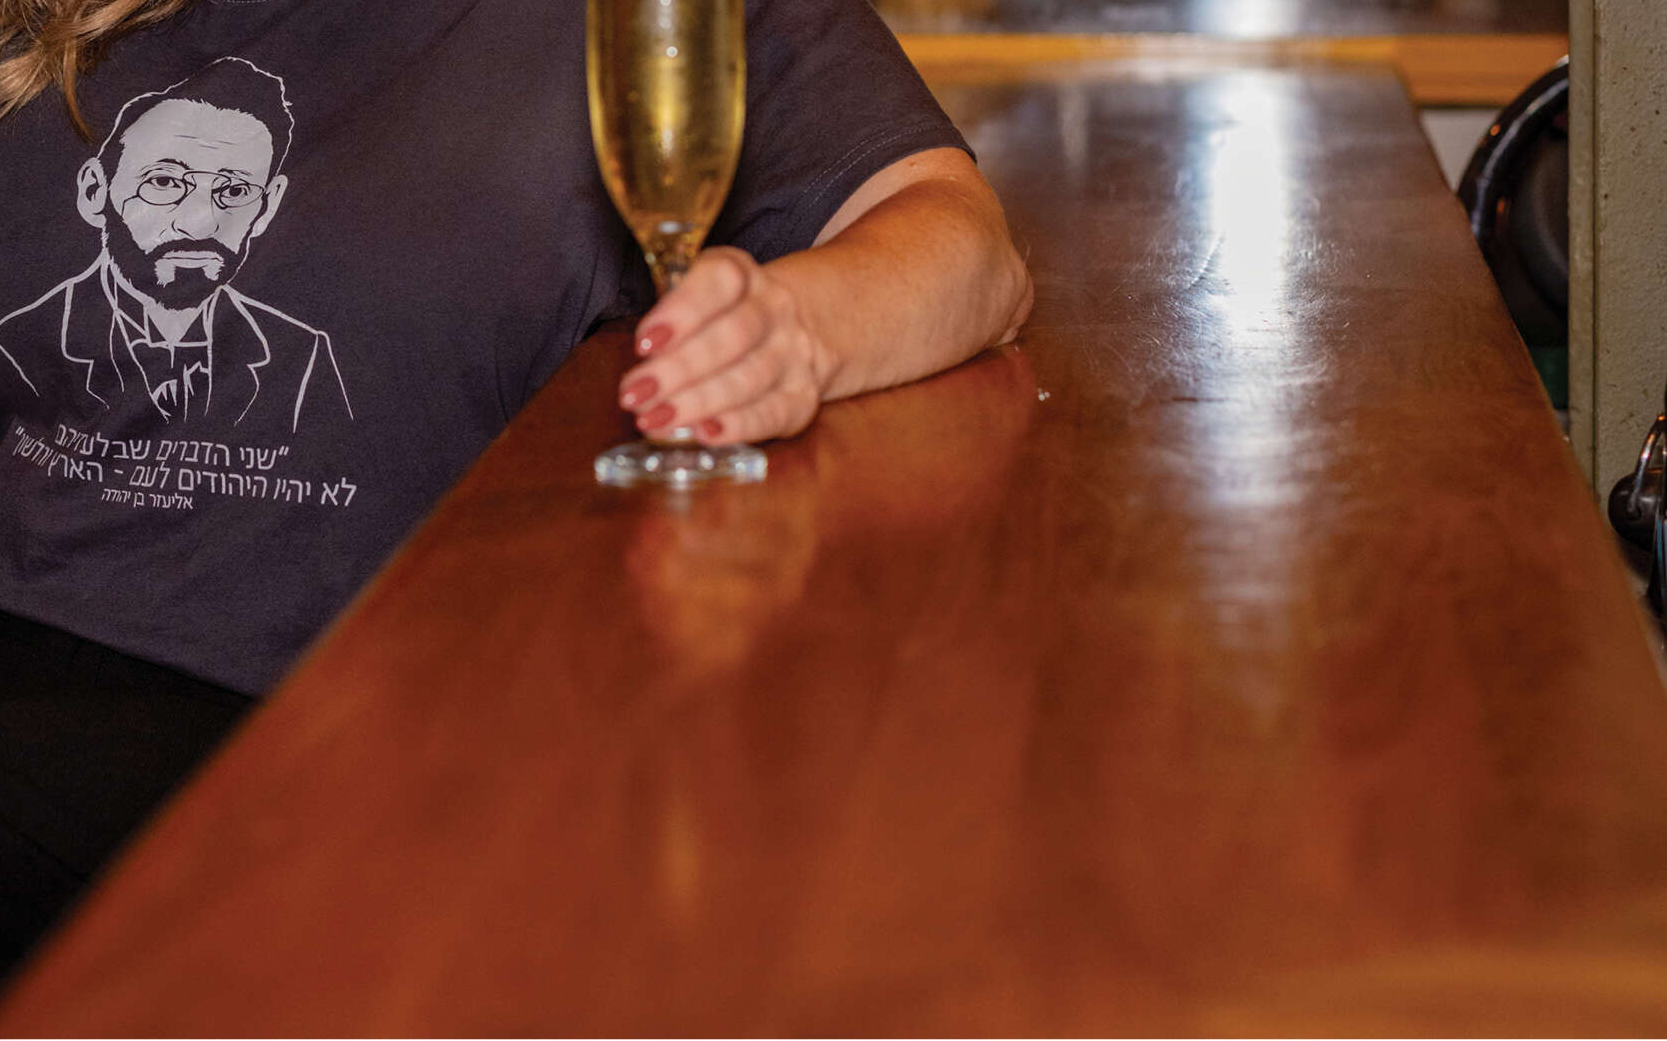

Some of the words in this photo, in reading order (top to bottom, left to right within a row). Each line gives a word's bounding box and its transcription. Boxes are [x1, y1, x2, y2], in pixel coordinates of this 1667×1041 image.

[156, 440, 231, 467] הדברים
[48, 452, 103, 483] הארץ
[129, 461, 171, 489] לעם
[101, 488, 131, 503] יהודה
[178, 468, 268, 498] היהודים
[274, 478, 311, 503] יהיו
[321, 477, 357, 507] לא
[133, 491, 145, 508] בן
[149, 492, 194, 510] אליעזר
